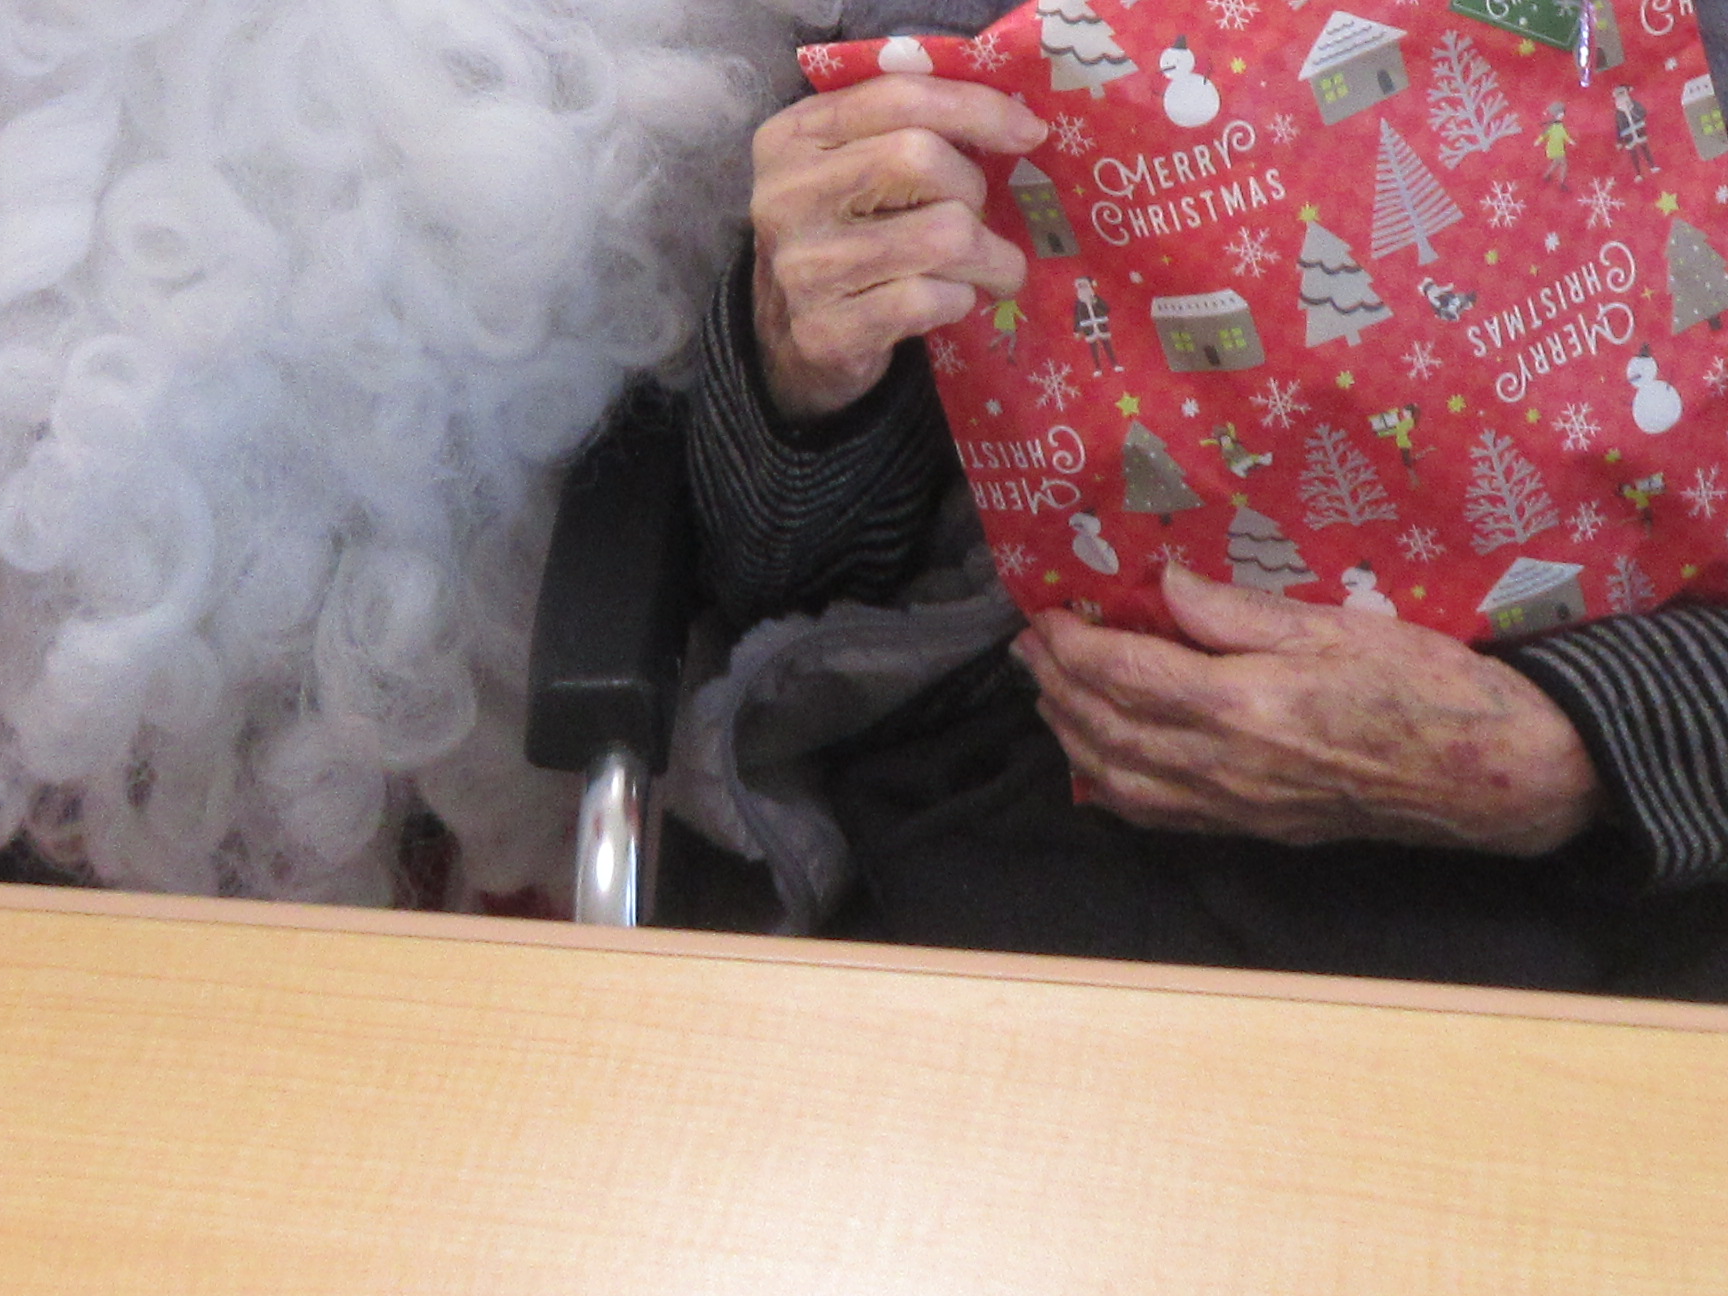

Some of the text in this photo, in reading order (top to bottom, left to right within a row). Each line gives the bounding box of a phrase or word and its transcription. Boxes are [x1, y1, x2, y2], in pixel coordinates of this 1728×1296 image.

[1093, 119, 1257, 200] MERRY
[1091, 167, 1287, 246] CHRISTMAS
[1467, 240, 1637, 357] CHRISTMAS
[1495, 301, 1636, 404] MERRY
[954, 424, 1087, 475] CHRIST
